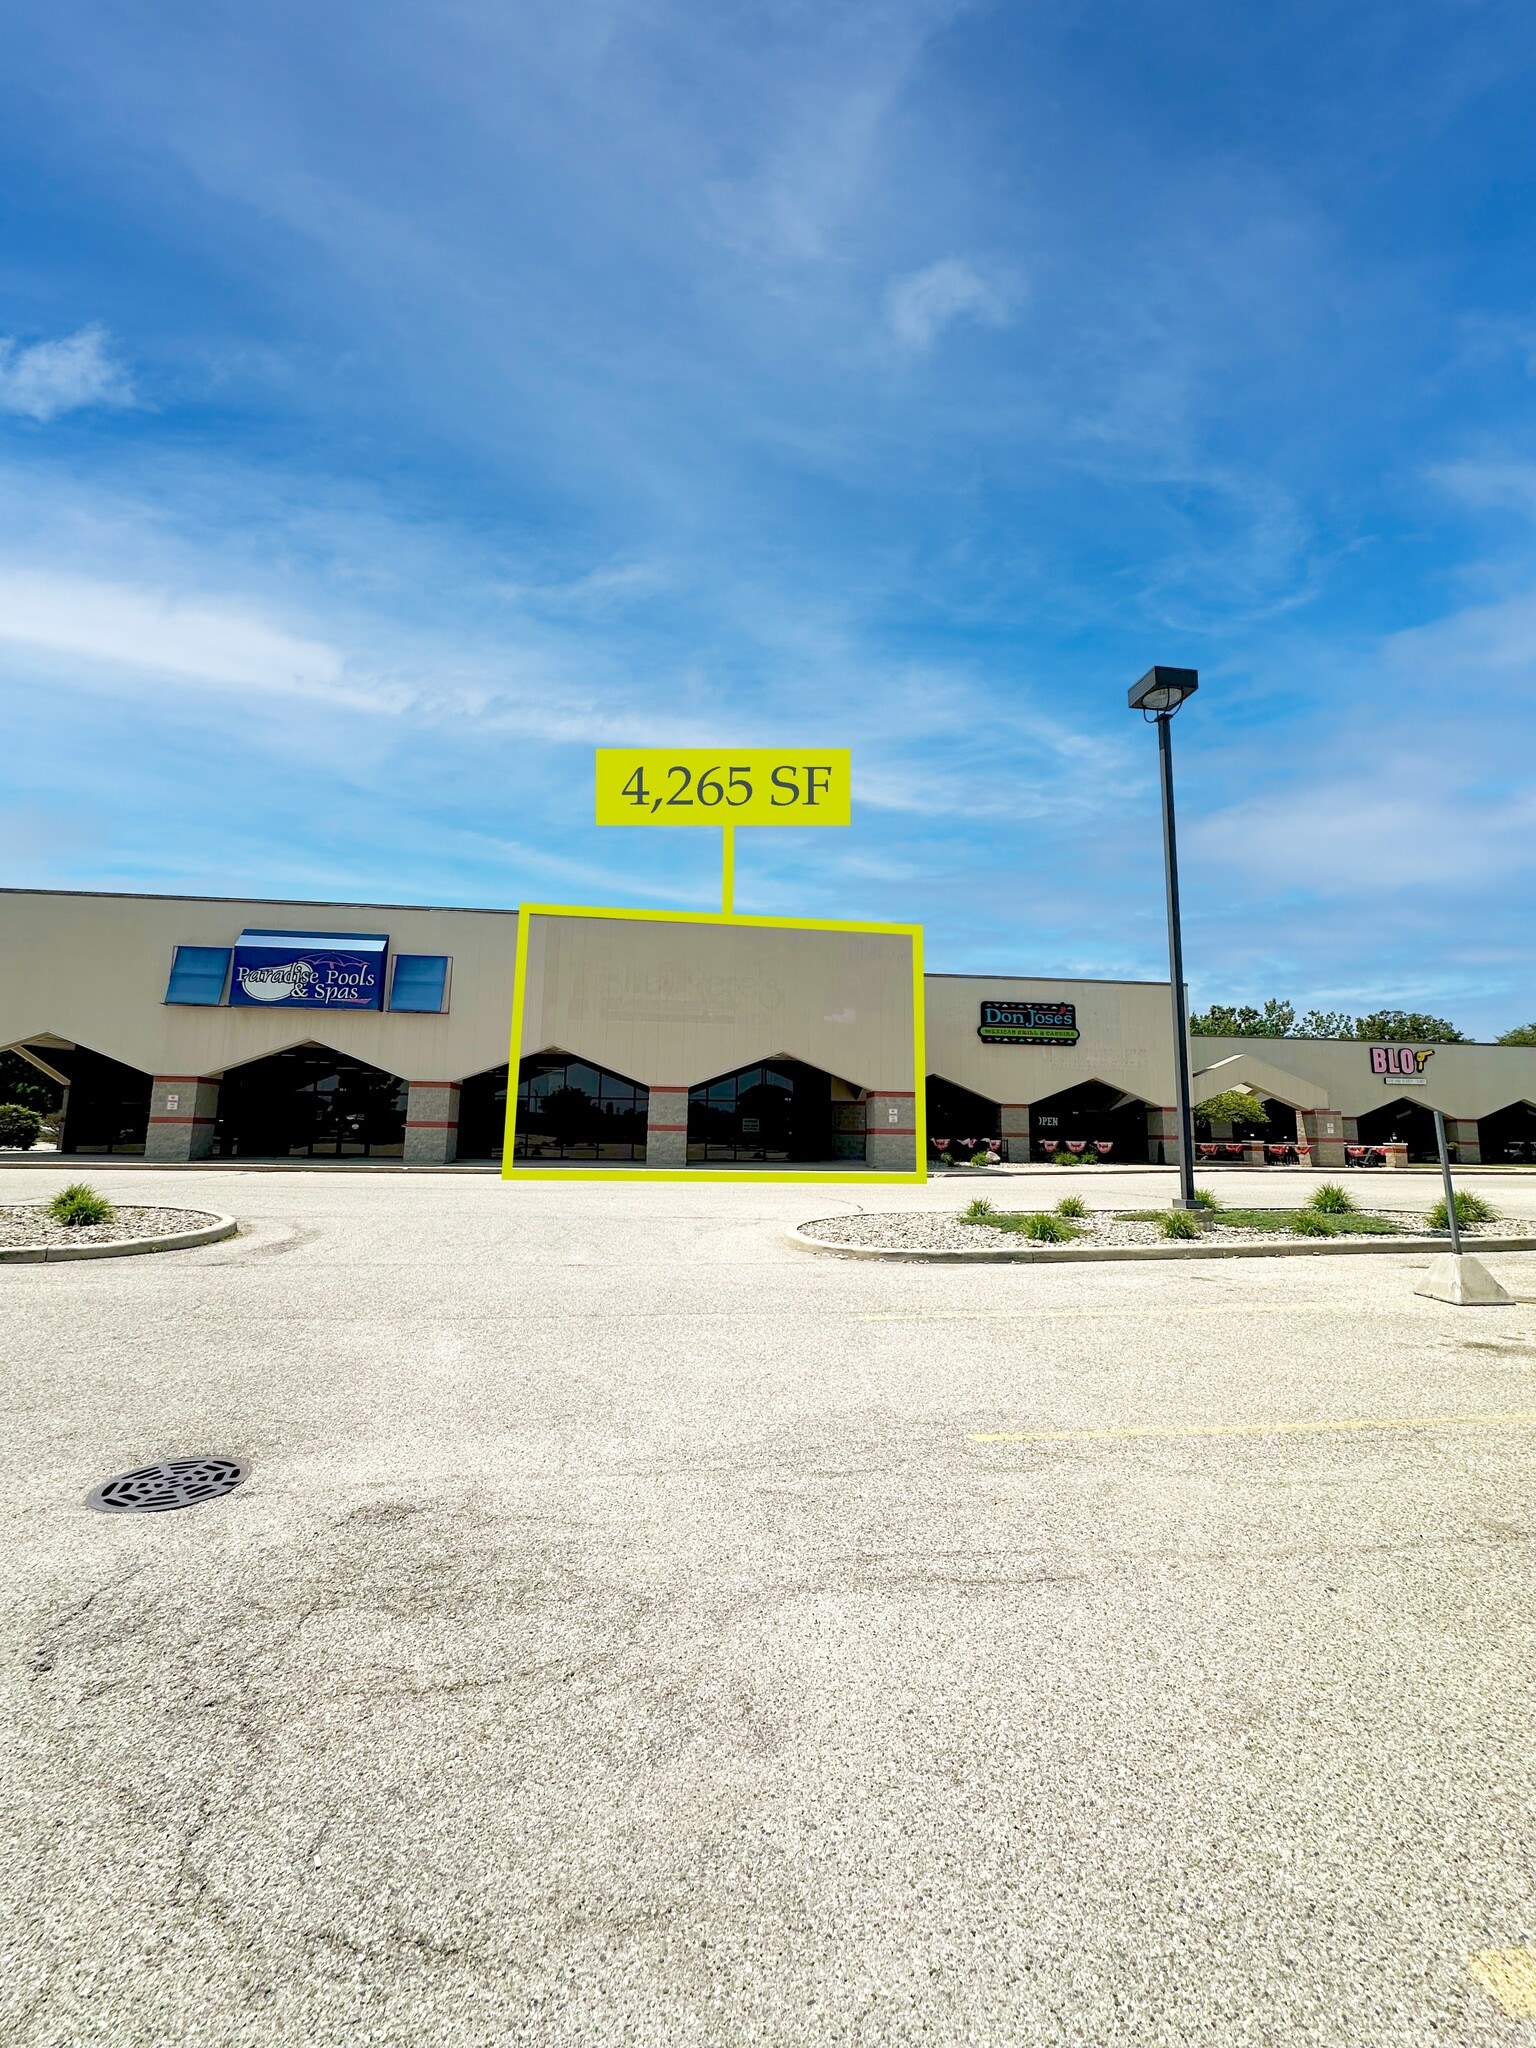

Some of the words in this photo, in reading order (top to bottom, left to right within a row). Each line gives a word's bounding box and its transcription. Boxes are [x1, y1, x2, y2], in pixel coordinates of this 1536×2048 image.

[236, 962, 319, 984] Paradise
[325, 964, 375, 986] Pools
[290, 983, 309, 998] &
[314, 983, 359, 1004] Spas
[985, 1008, 1025, 1024] Don
[1370, 1047, 1415, 1074] BLO
